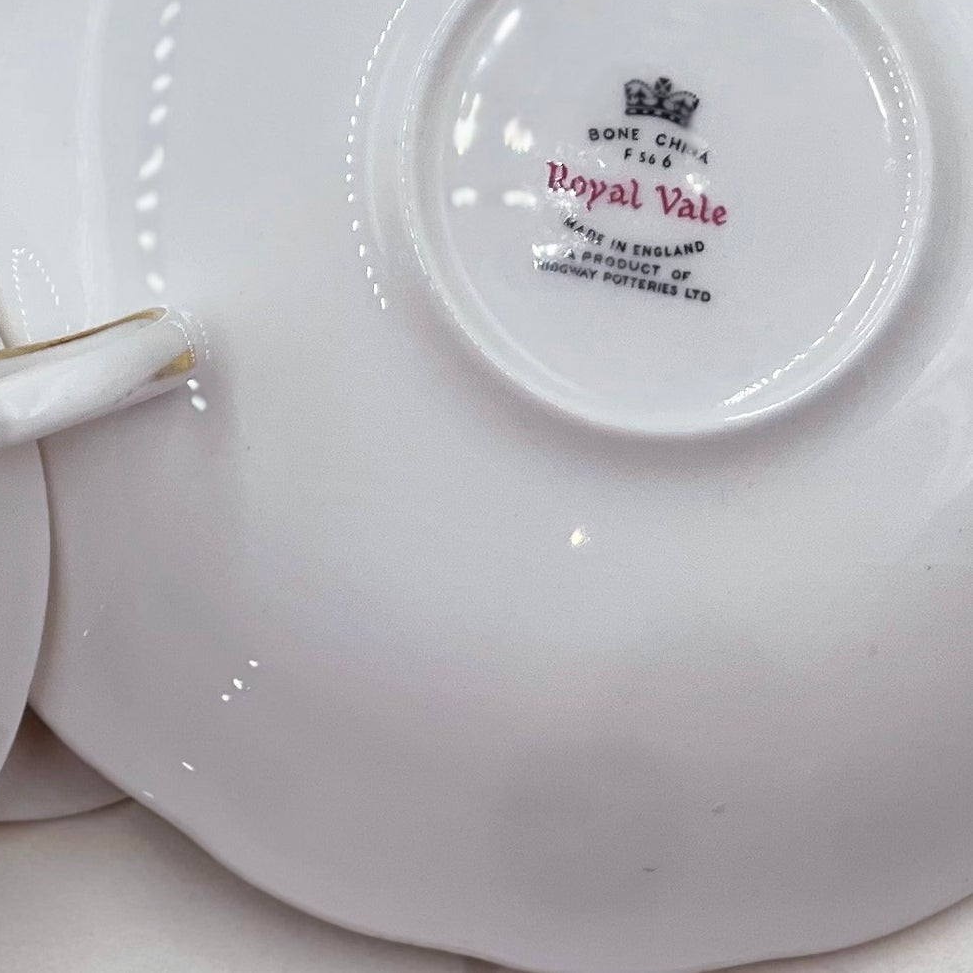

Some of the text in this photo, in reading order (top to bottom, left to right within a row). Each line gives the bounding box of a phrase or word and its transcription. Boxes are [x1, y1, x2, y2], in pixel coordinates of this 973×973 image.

[589, 128, 709, 164] BONE CHIA
[624, 148, 632, 160] F
[547, 160, 727, 226] Royal Vale
[610, 238, 626, 252] IN
[633, 241, 704, 257] ENGLAND
[582, 251, 660, 276] PRODUCT
[672, 270, 691, 281] OF
[603, 272, 677, 295] POTTERIES
[685, 288, 711, 302] LTD
